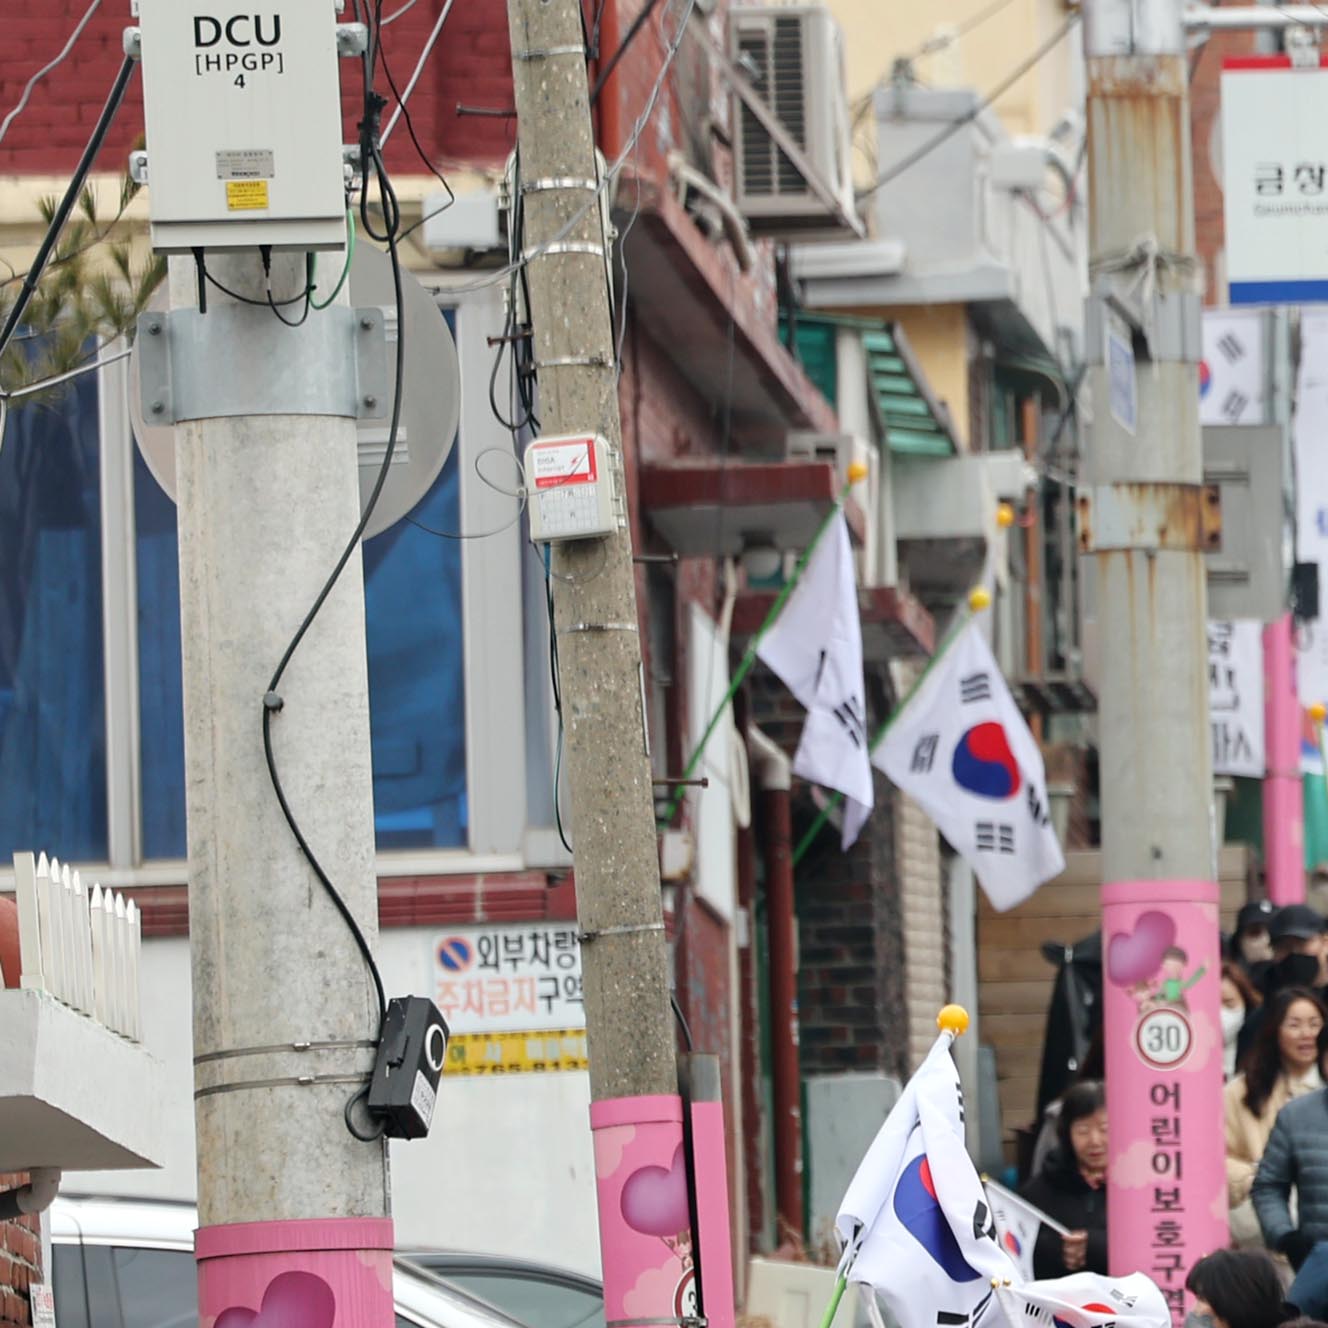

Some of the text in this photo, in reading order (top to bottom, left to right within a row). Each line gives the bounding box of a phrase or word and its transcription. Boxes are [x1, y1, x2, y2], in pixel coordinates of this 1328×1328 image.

[193, 14, 281, 48] DCU
[195, 53, 284, 76] [HPGP]
[234, 74, 246, 88] 4
[478, 930, 578, 973] 외부차량
[1146, 1026, 1182, 1052] 30
